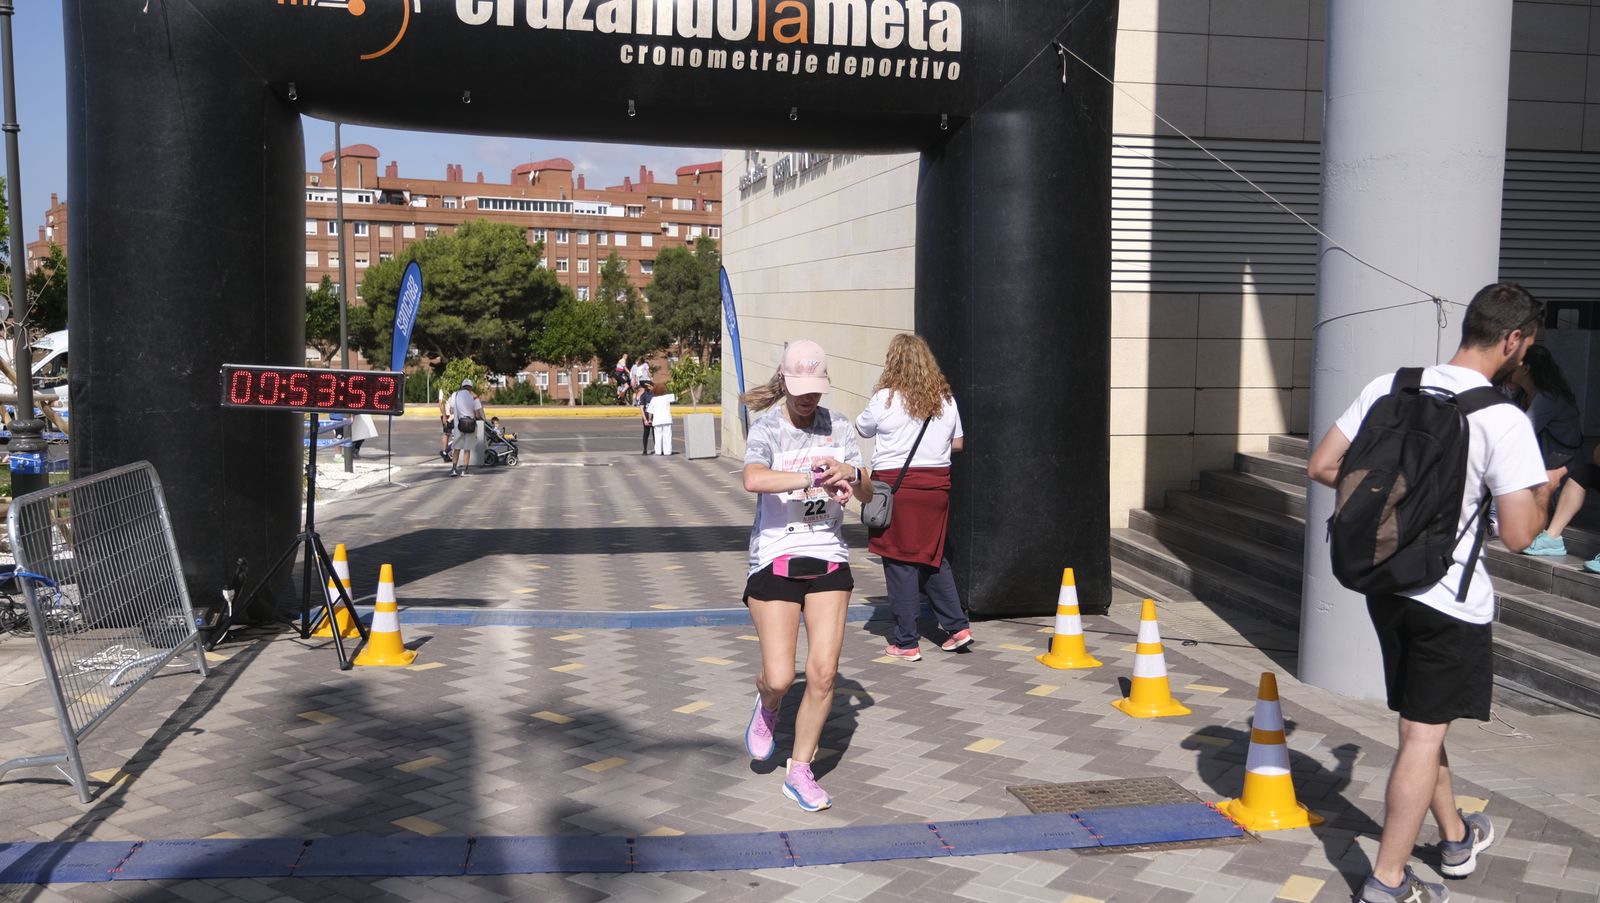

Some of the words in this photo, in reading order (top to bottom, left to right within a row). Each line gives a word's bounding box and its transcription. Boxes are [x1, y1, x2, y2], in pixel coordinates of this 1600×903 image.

[620, 44, 819, 75] cronometraje
[827, 52, 961, 81] deportivo
[804, 499, 826, 516] 22
